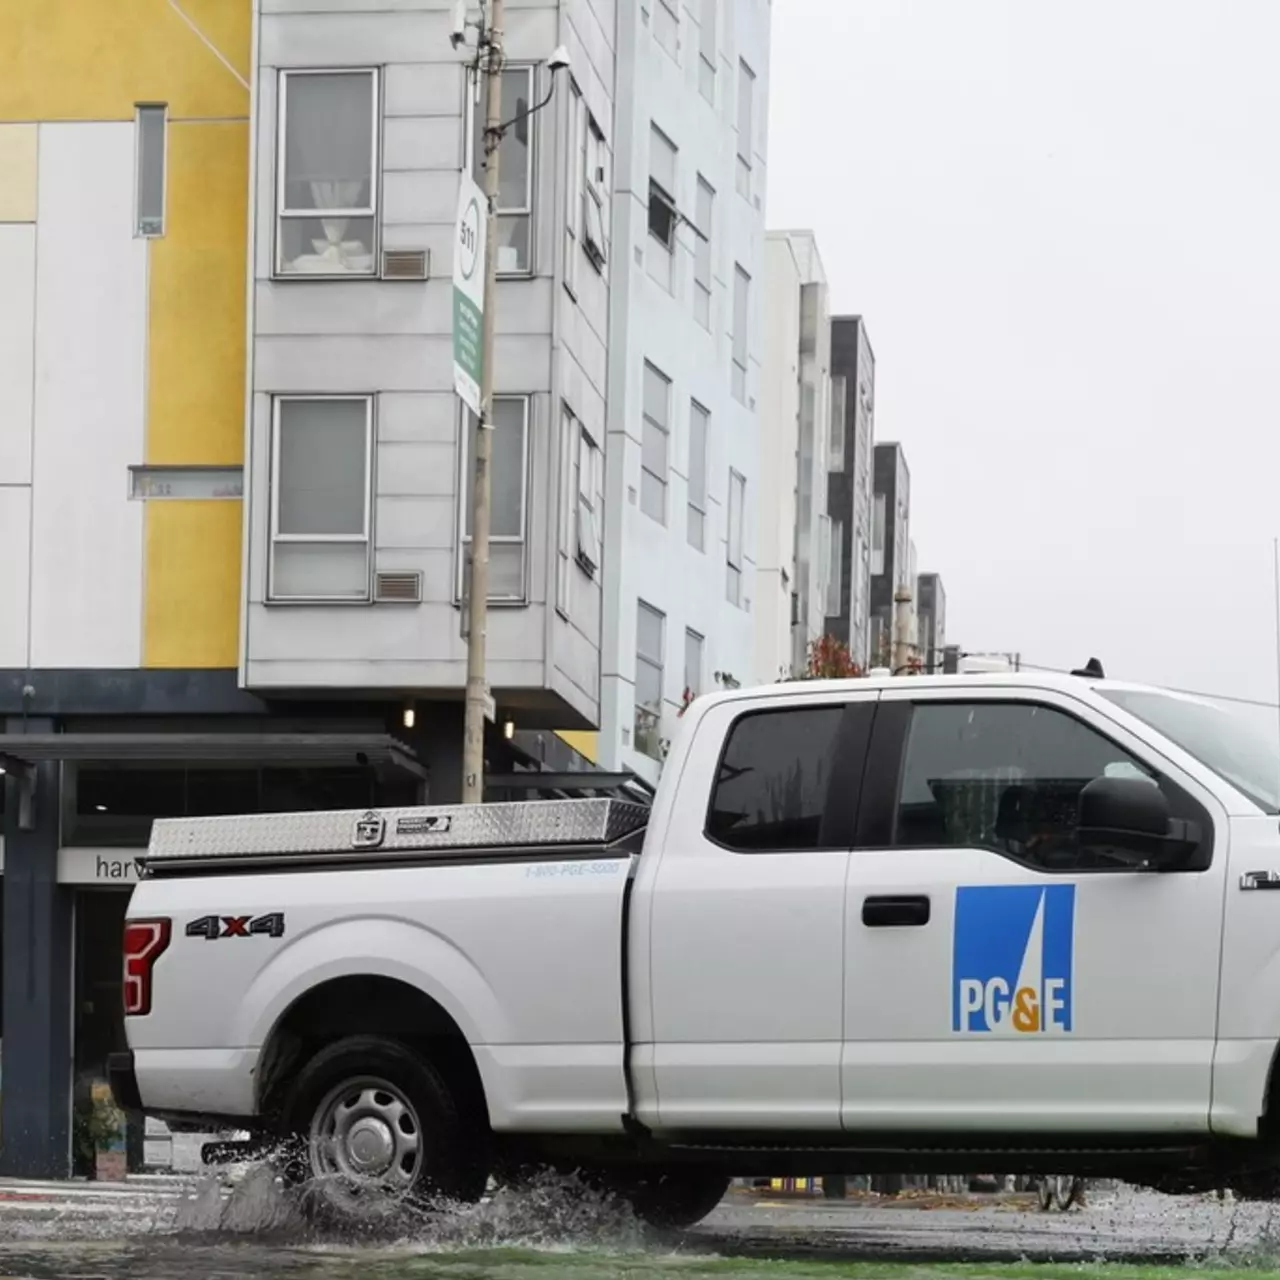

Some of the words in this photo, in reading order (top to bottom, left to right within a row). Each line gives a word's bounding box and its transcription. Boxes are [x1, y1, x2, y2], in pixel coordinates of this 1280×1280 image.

[461, 220, 474, 254] 511
[96, 855, 145, 878] harv
[959, 976, 1065, 1032] PG&E
